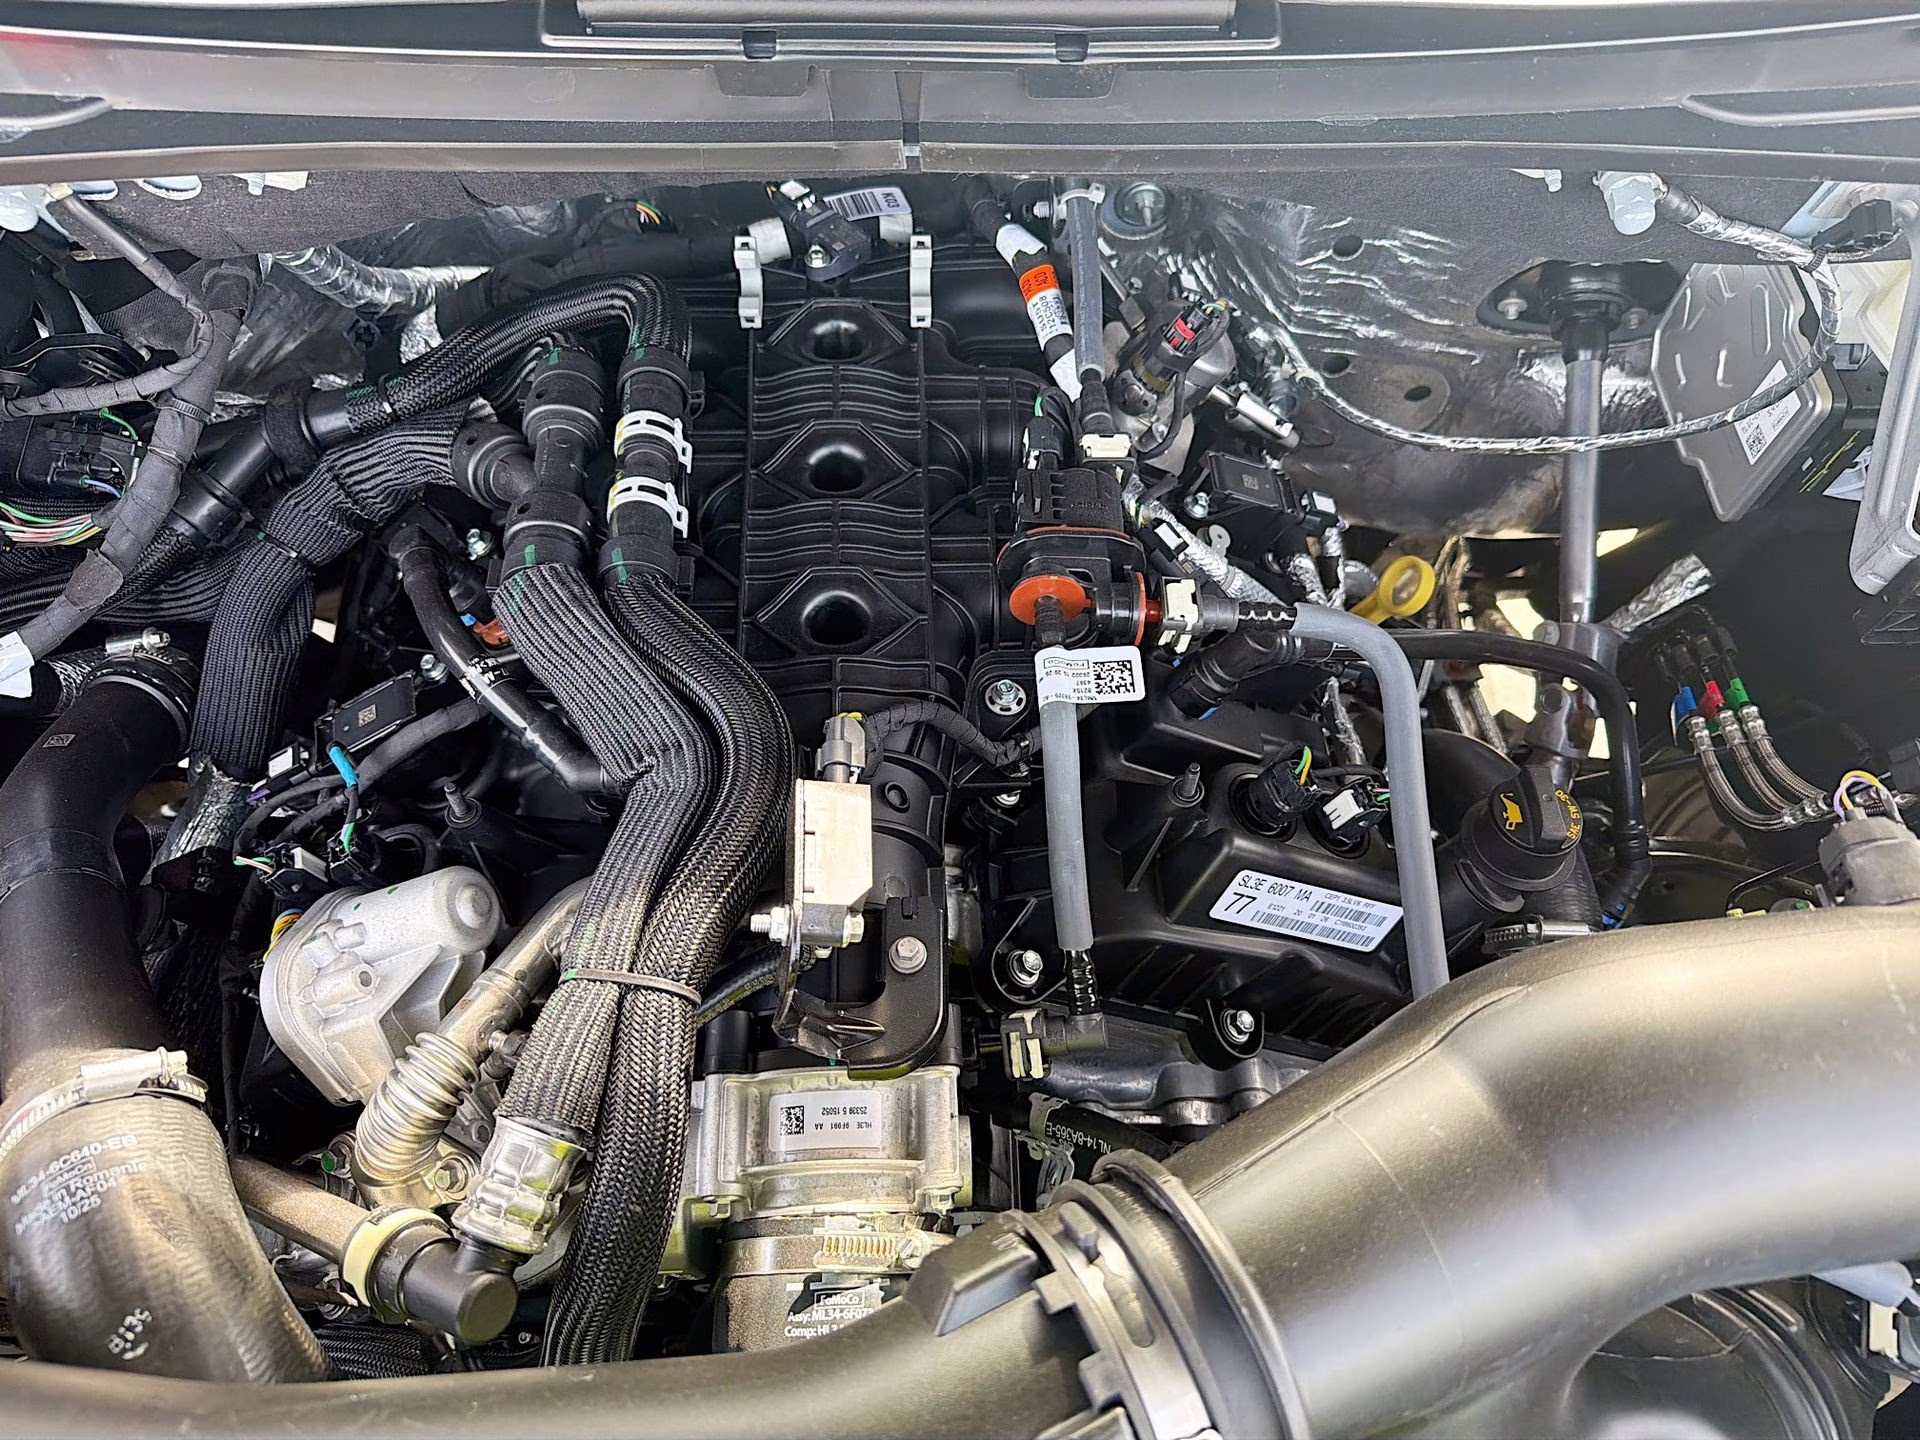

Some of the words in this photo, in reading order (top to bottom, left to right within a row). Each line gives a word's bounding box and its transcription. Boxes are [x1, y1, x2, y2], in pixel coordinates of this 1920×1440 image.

[882, 192, 900, 208] K03
[1555, 789, 1580, 819] 5W-30
[1566, 822, 1581, 839] SAE
[1238, 874, 1267, 891] SL3E
[1267, 882, 1295, 897] 6007
[1293, 888, 1313, 902] MA
[1224, 892, 1257, 914] 77
[842, 1106, 847, 1115] 5
[814, 1122, 824, 1130] AA
[856, 1121, 872, 1129] HL3E
[820, 1293, 860, 1306] FoMoCo
